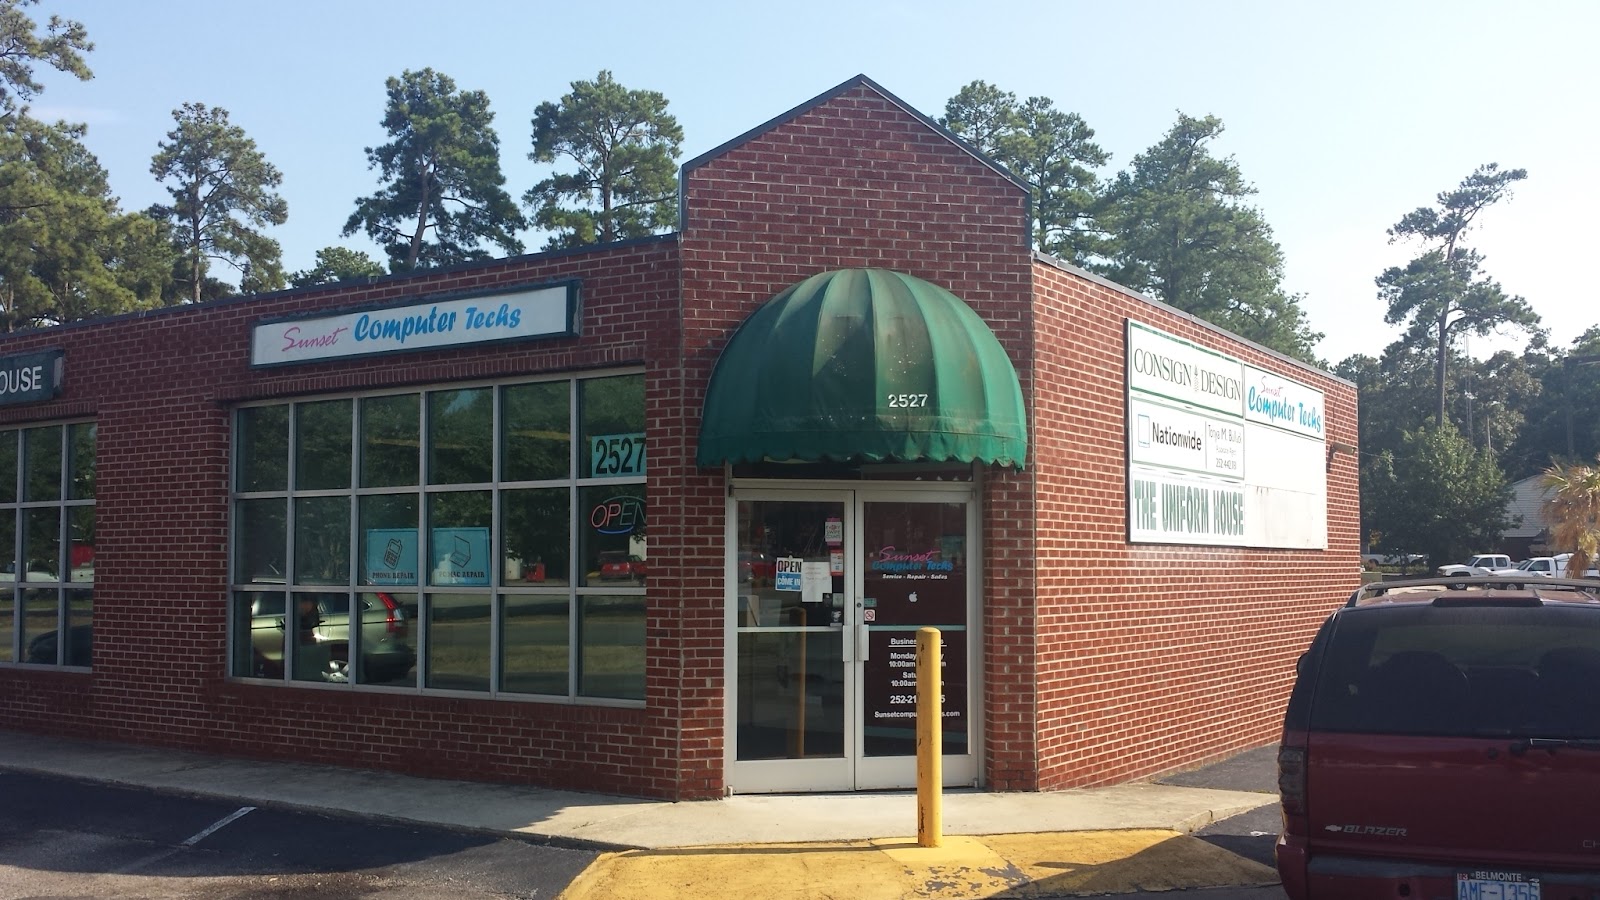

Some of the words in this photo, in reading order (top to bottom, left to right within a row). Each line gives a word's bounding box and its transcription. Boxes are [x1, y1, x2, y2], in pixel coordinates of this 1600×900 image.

[282, 327, 348, 352] Sunset
[354, 306, 456, 343] Computer
[465, 304, 521, 330] Techs
[1134, 348, 1192, 387] CONSIGN
[1201, 369, 1241, 401] DESIGN
[888, 394, 928, 408] 2527
[1248, 386, 1295, 423] Computer
[1298, 402, 1321, 433] Techs
[1152, 422, 1202, 451] Nationwide
[596, 438, 646, 475] 2527
[592, 501, 647, 528] OPEN
[1134, 480, 1156, 531] THE
[1162, 483, 1209, 533] UNIFORM
[1213, 489, 1243, 536] HOUSE
[880, 546, 941, 562] Sunset
[778, 560, 802, 573] OPEN
[872, 561, 922, 572] Computer
[927, 560, 954, 571] Techs
[778, 577, 794, 586] COME
[1343, 824, 1407, 836] BLAZER
[1475, 871, 1522, 882] BELMONTE
